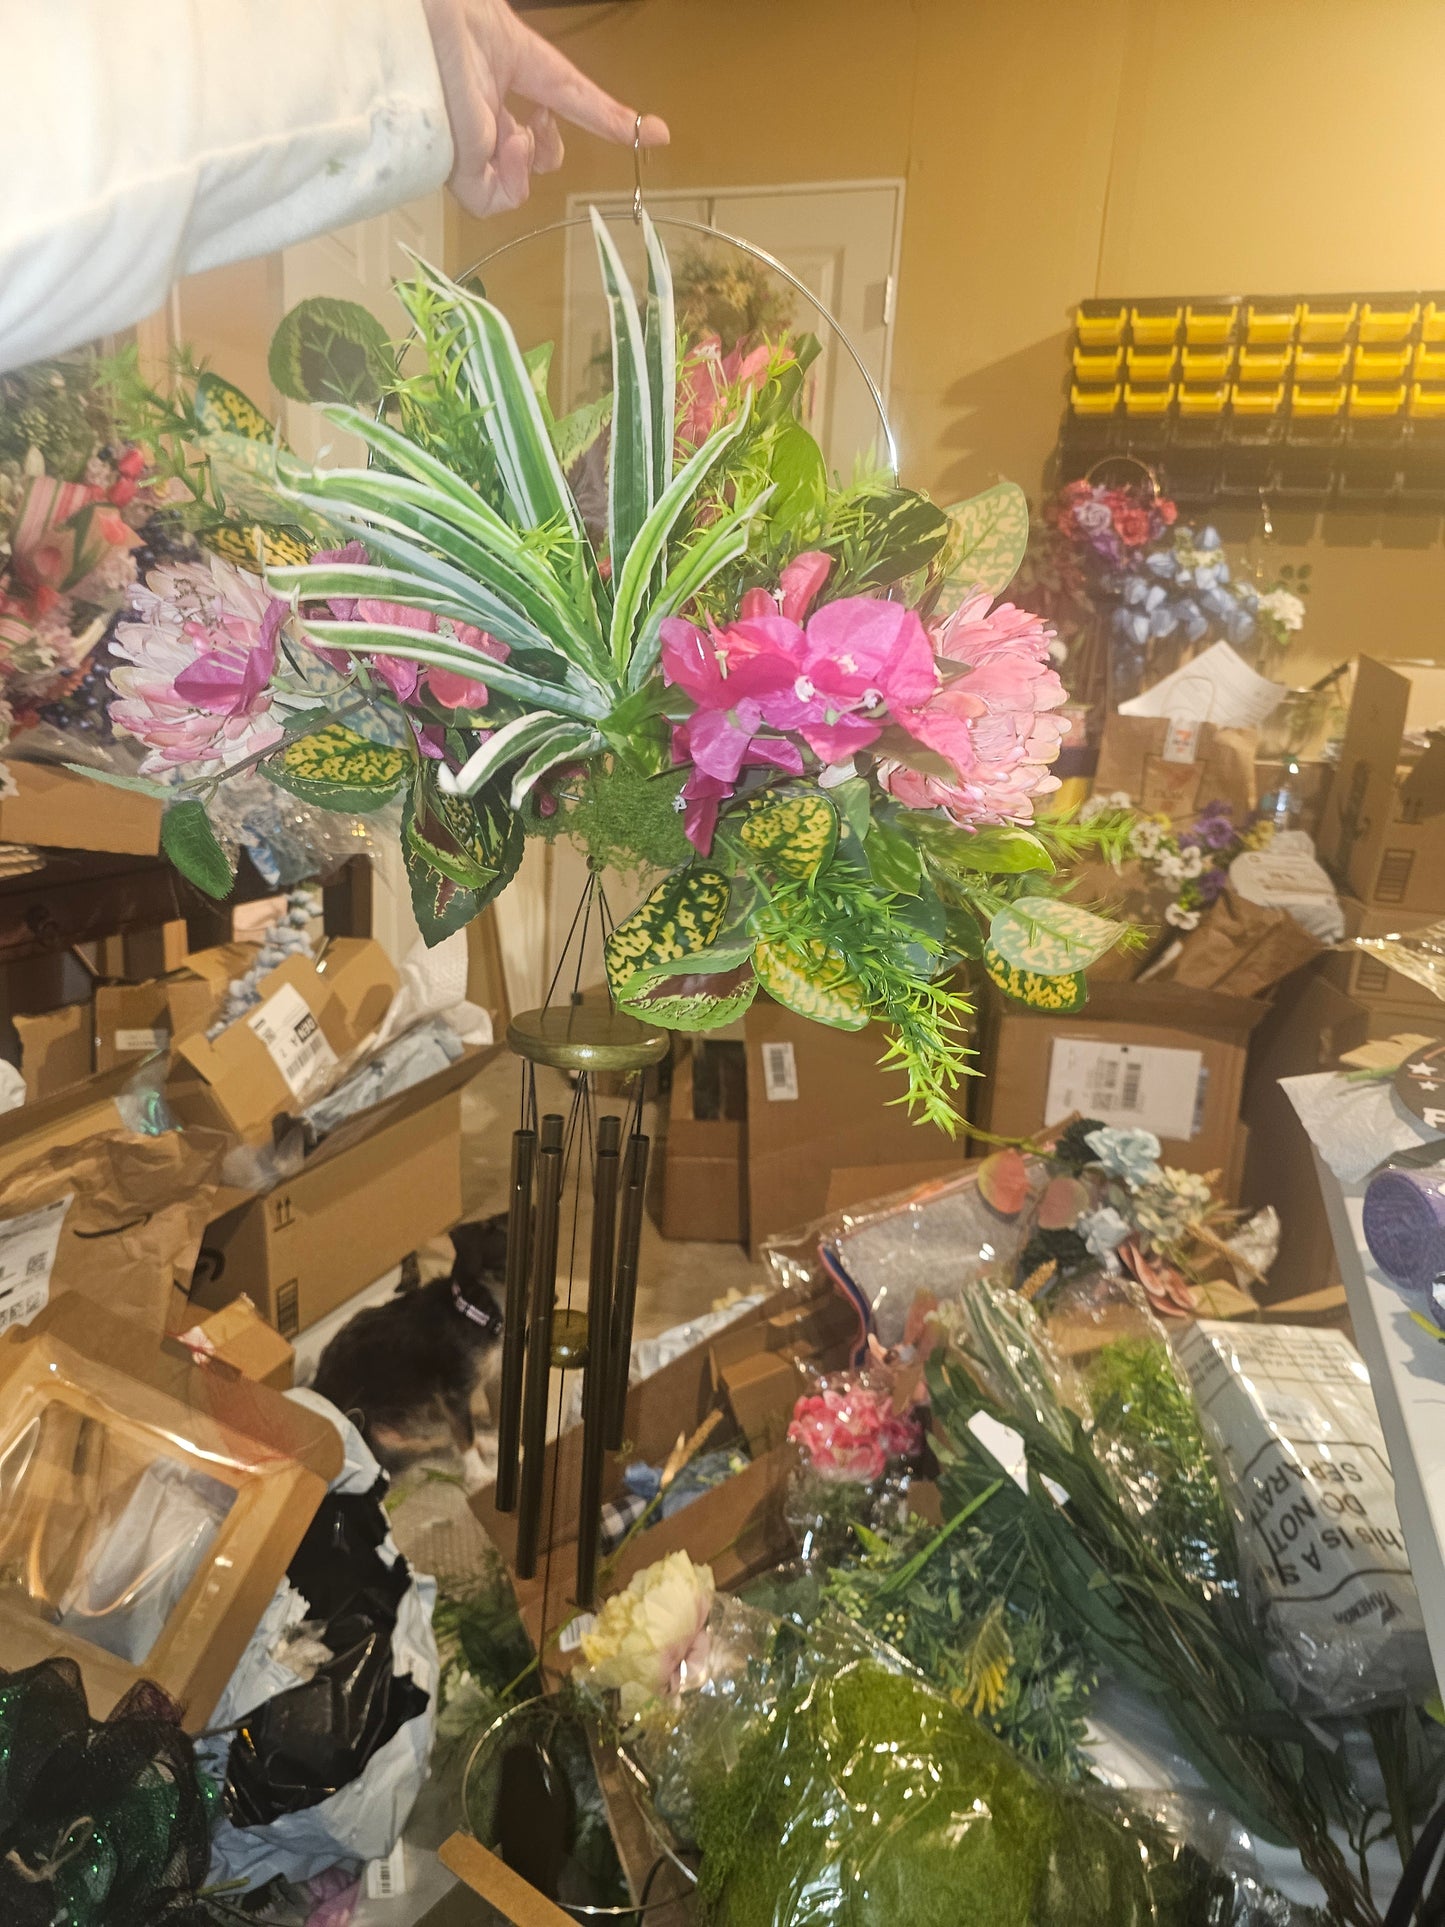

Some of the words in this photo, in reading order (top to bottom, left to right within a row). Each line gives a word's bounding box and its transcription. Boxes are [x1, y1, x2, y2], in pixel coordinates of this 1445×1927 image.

[1249, 1460, 1363, 1524] SEPARAT
[1321, 1491, 1368, 1516] DO
[1270, 1495, 1317, 1554] NOT
[1355, 1527, 1405, 1551] his
[1301, 1542, 1322, 1573] A
